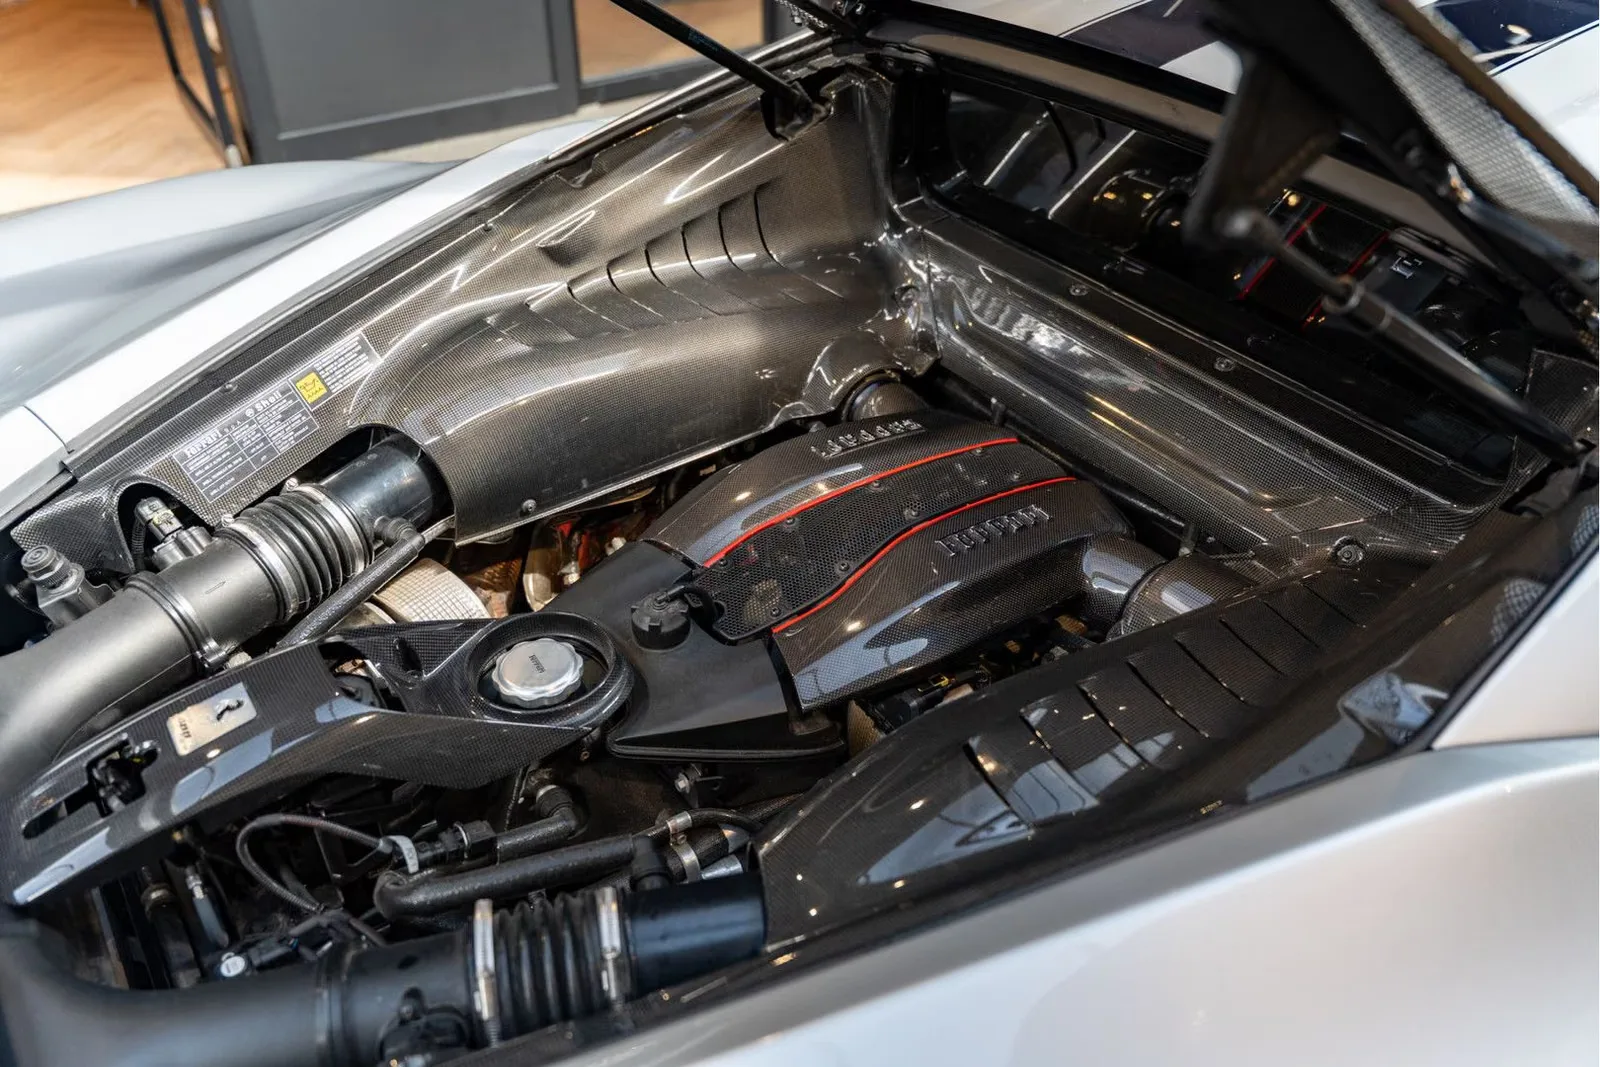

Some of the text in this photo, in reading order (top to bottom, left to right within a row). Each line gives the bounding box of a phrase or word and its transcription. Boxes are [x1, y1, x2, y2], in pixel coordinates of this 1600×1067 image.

[183, 430, 223, 458] Ferrari
[254, 391, 283, 412] Shell
[934, 504, 1050, 557] Ferrari
